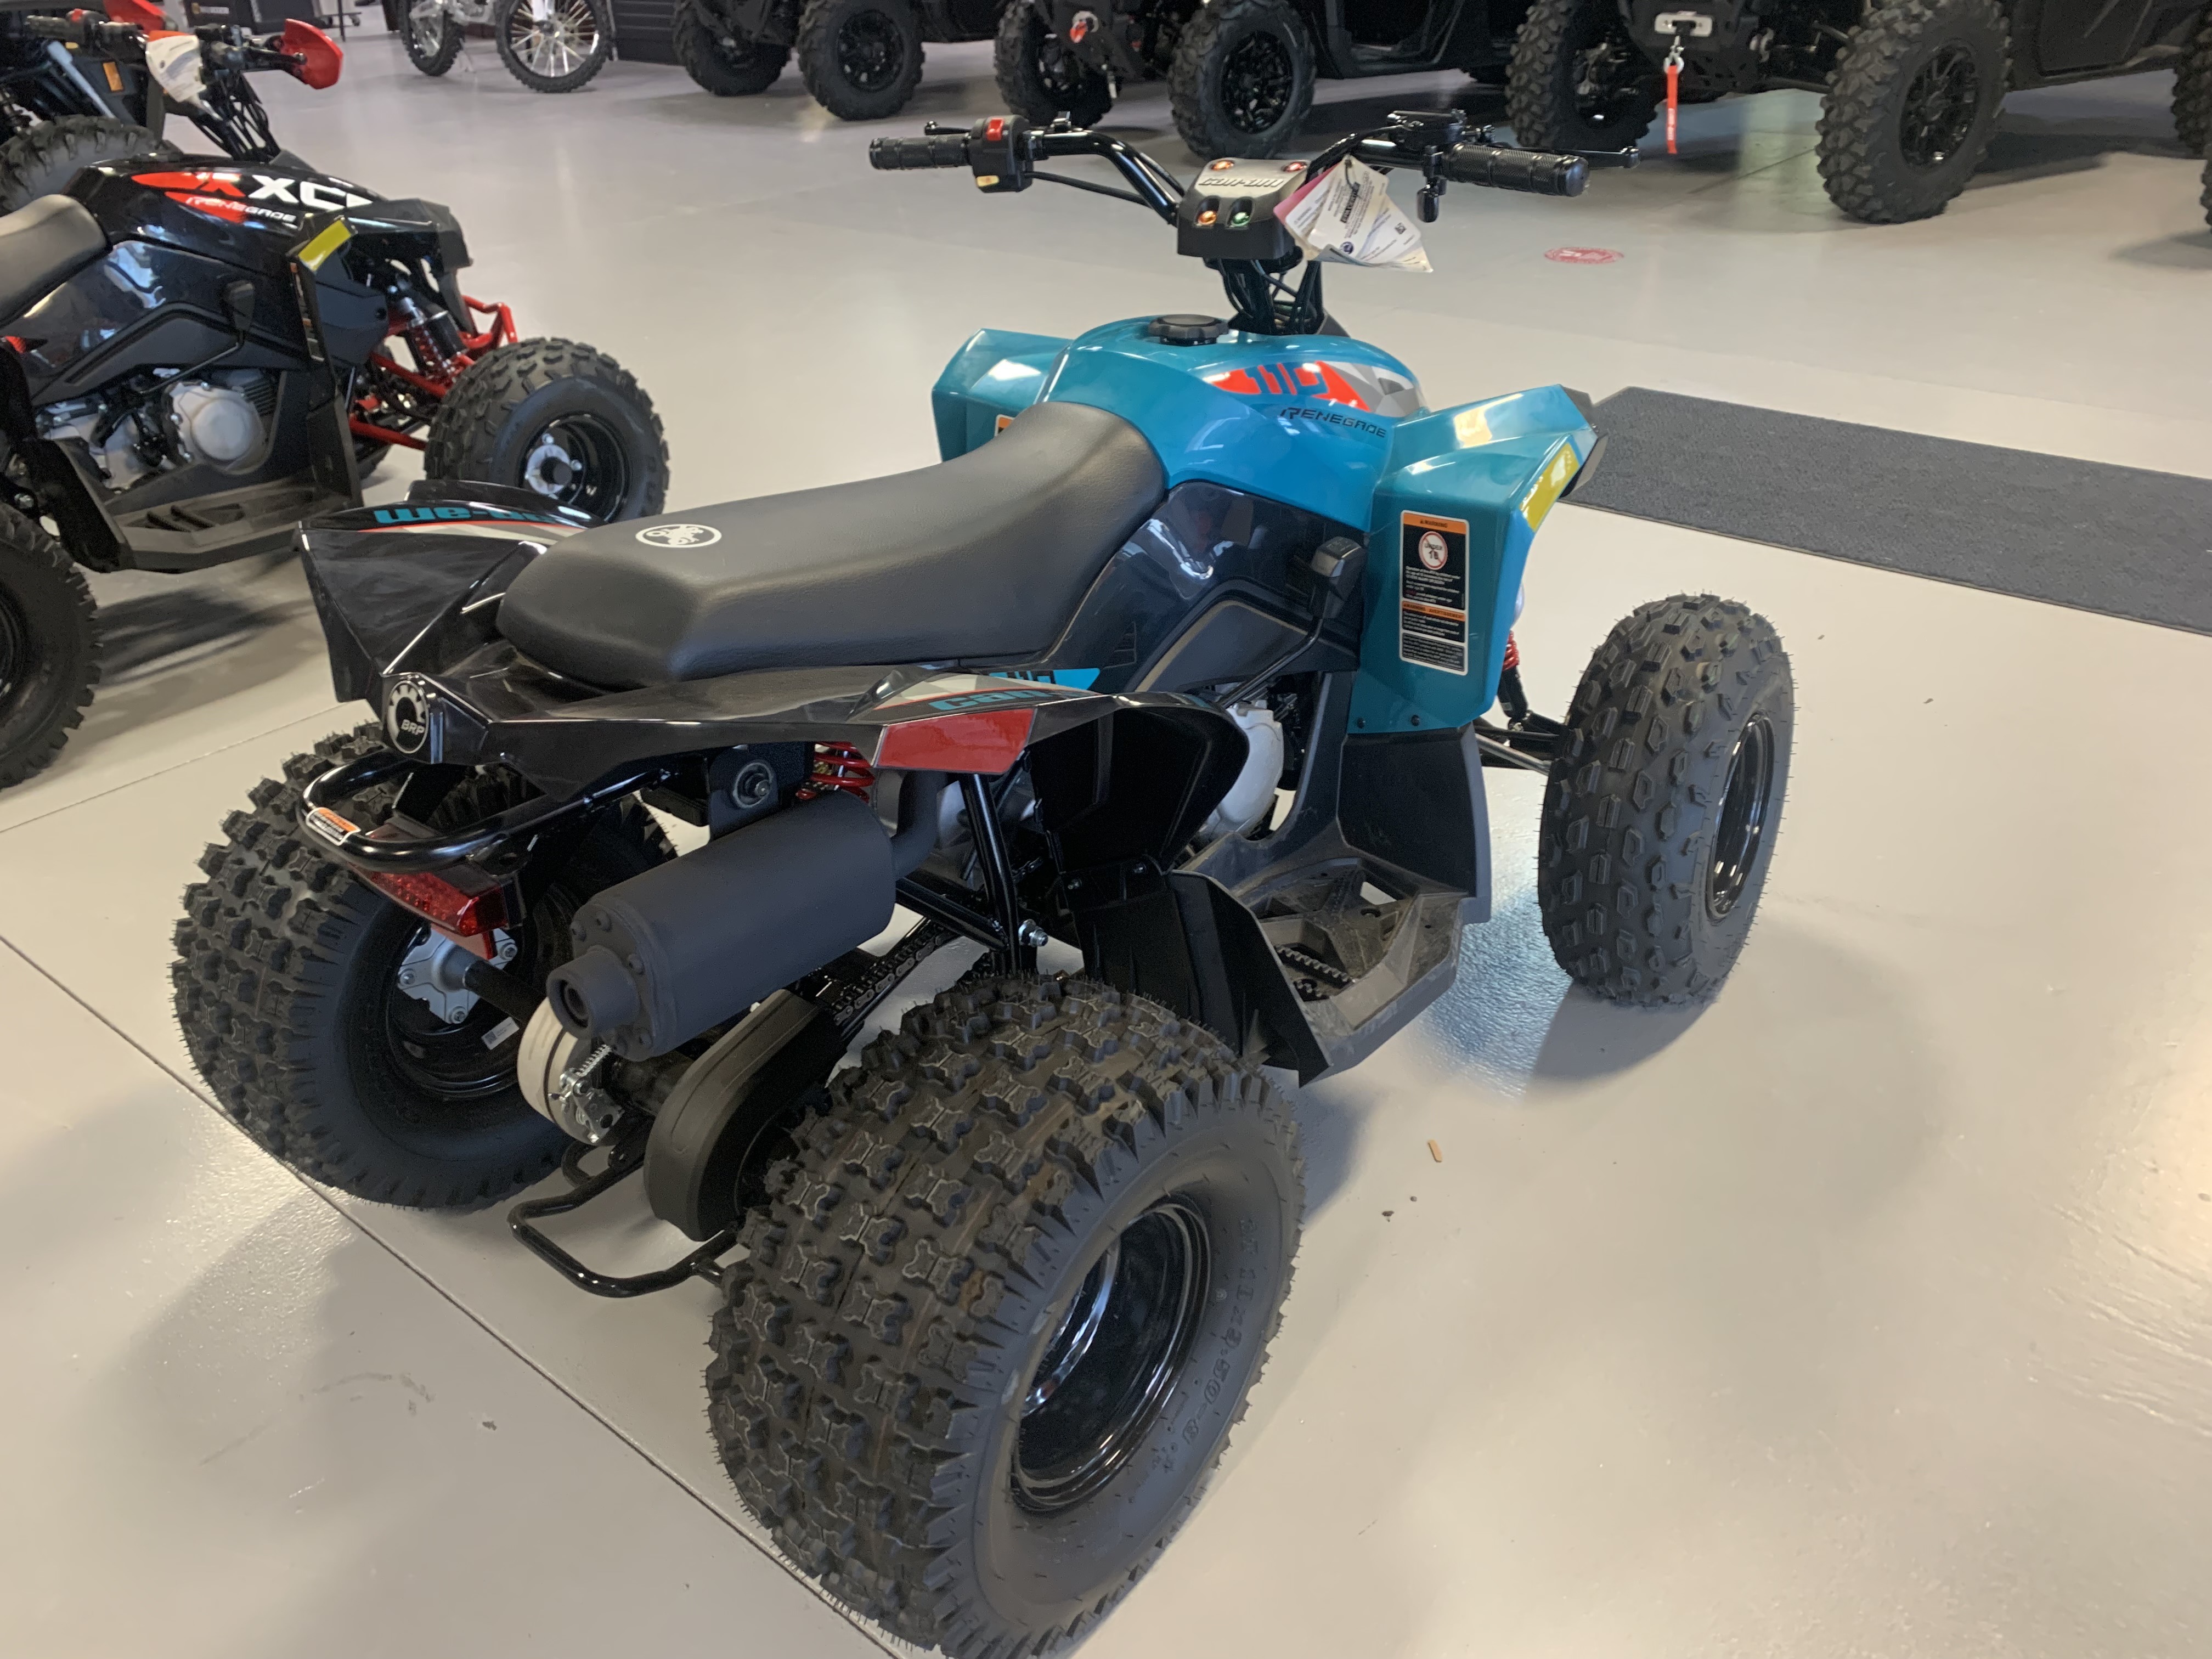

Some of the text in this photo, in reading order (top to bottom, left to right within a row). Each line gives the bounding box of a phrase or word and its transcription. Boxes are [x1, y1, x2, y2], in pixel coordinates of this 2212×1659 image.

[1198, 178, 1284, 188] can-am
[1279, 407, 1387, 438] RENEGADE
[374, 507, 555, 524] an-am
[400, 719, 425, 735] BRP
